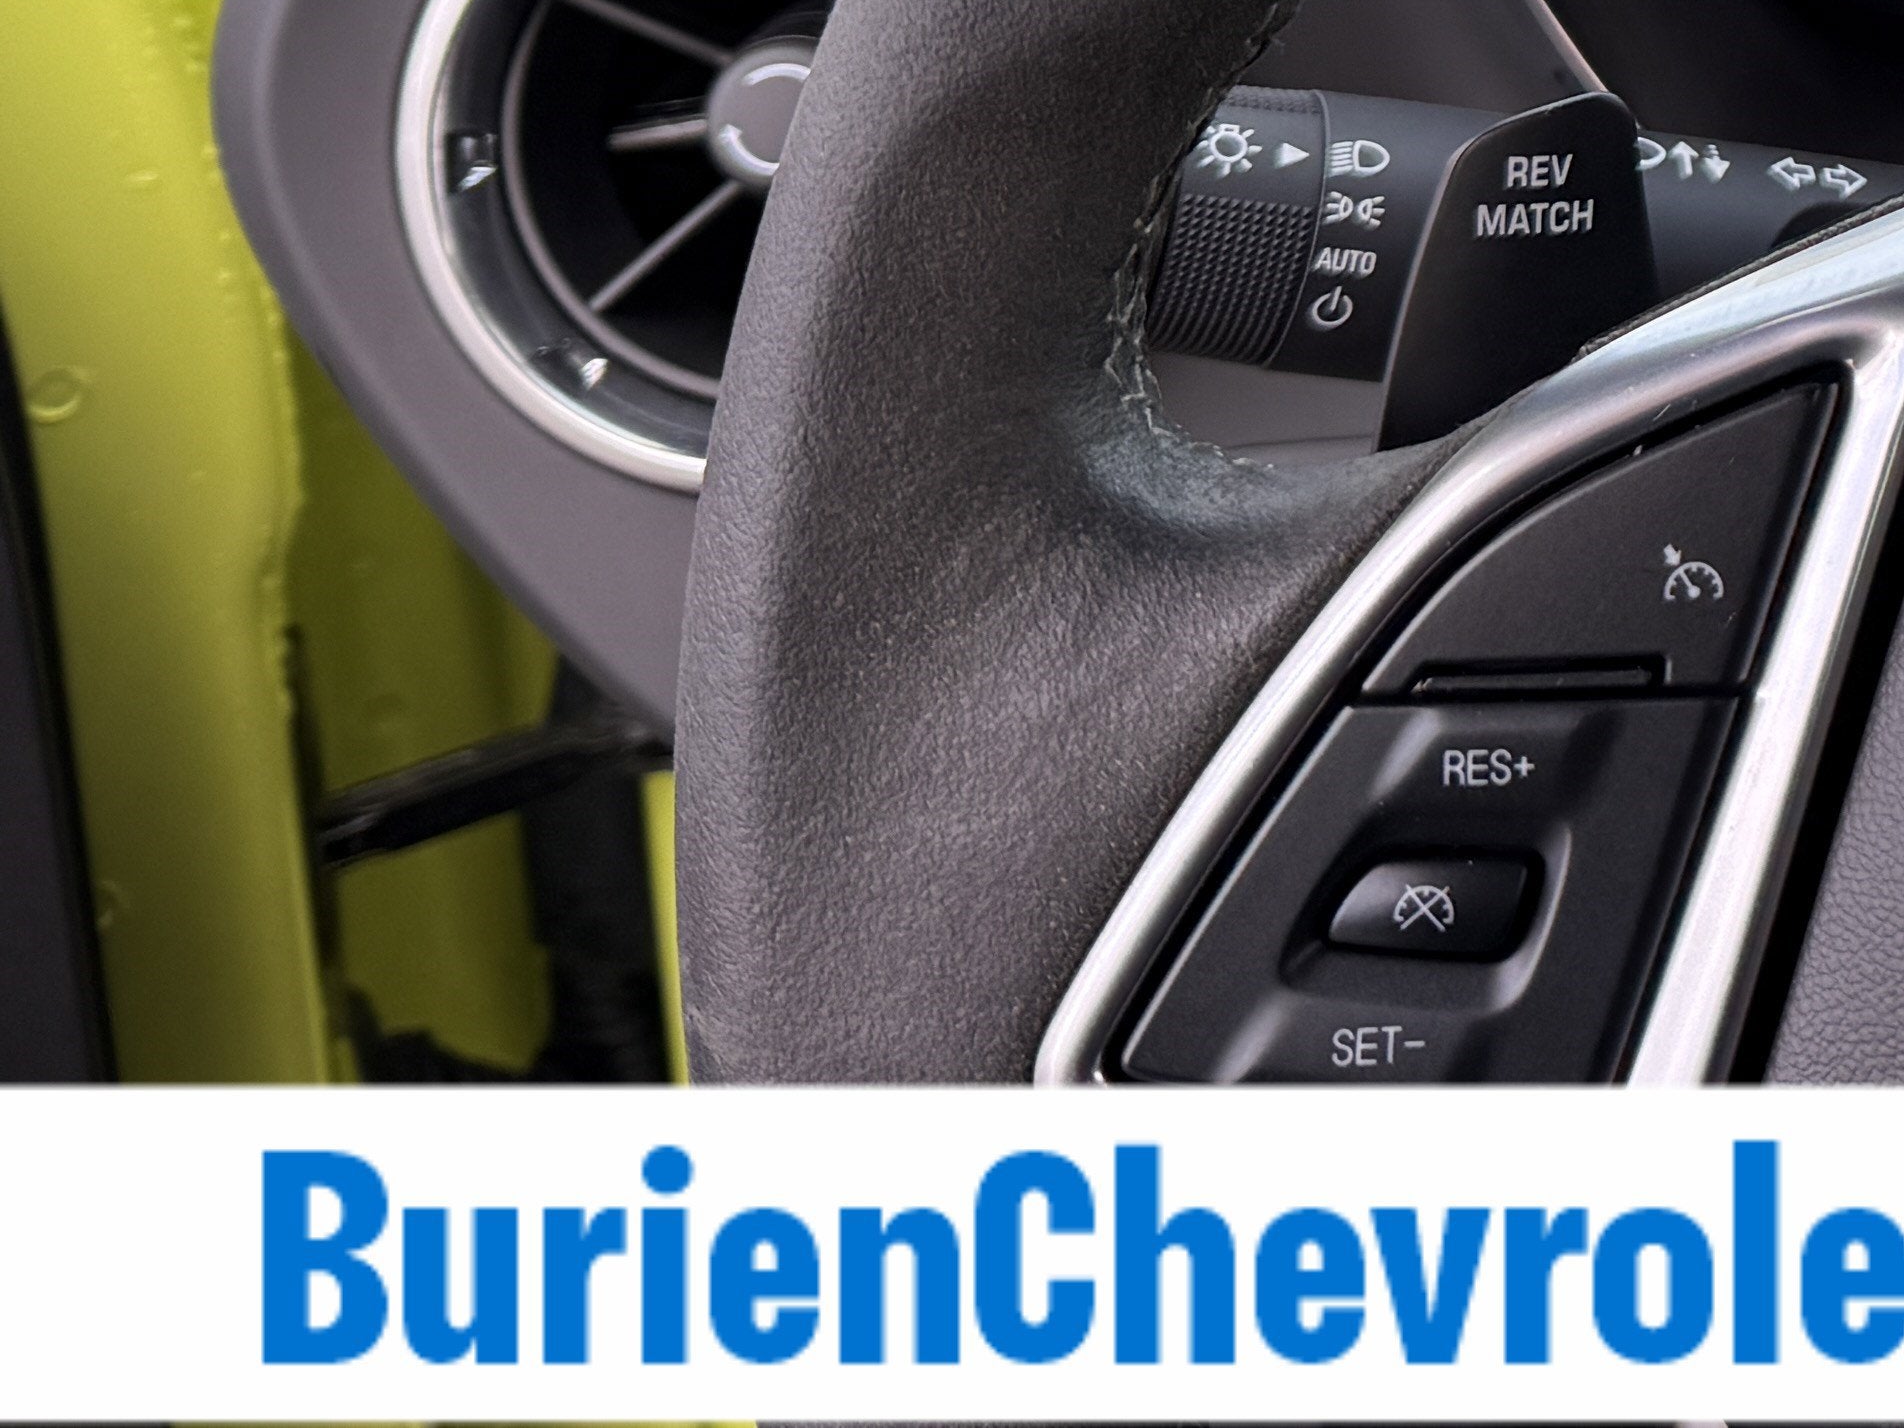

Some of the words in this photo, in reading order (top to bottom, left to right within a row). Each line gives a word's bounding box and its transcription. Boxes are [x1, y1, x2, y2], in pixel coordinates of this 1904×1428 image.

[1504, 153, 1575, 190] REV
[1476, 198, 1594, 238] MATCH
[1315, 248, 1377, 276] AUTO
[1442, 750, 1536, 787] RES+
